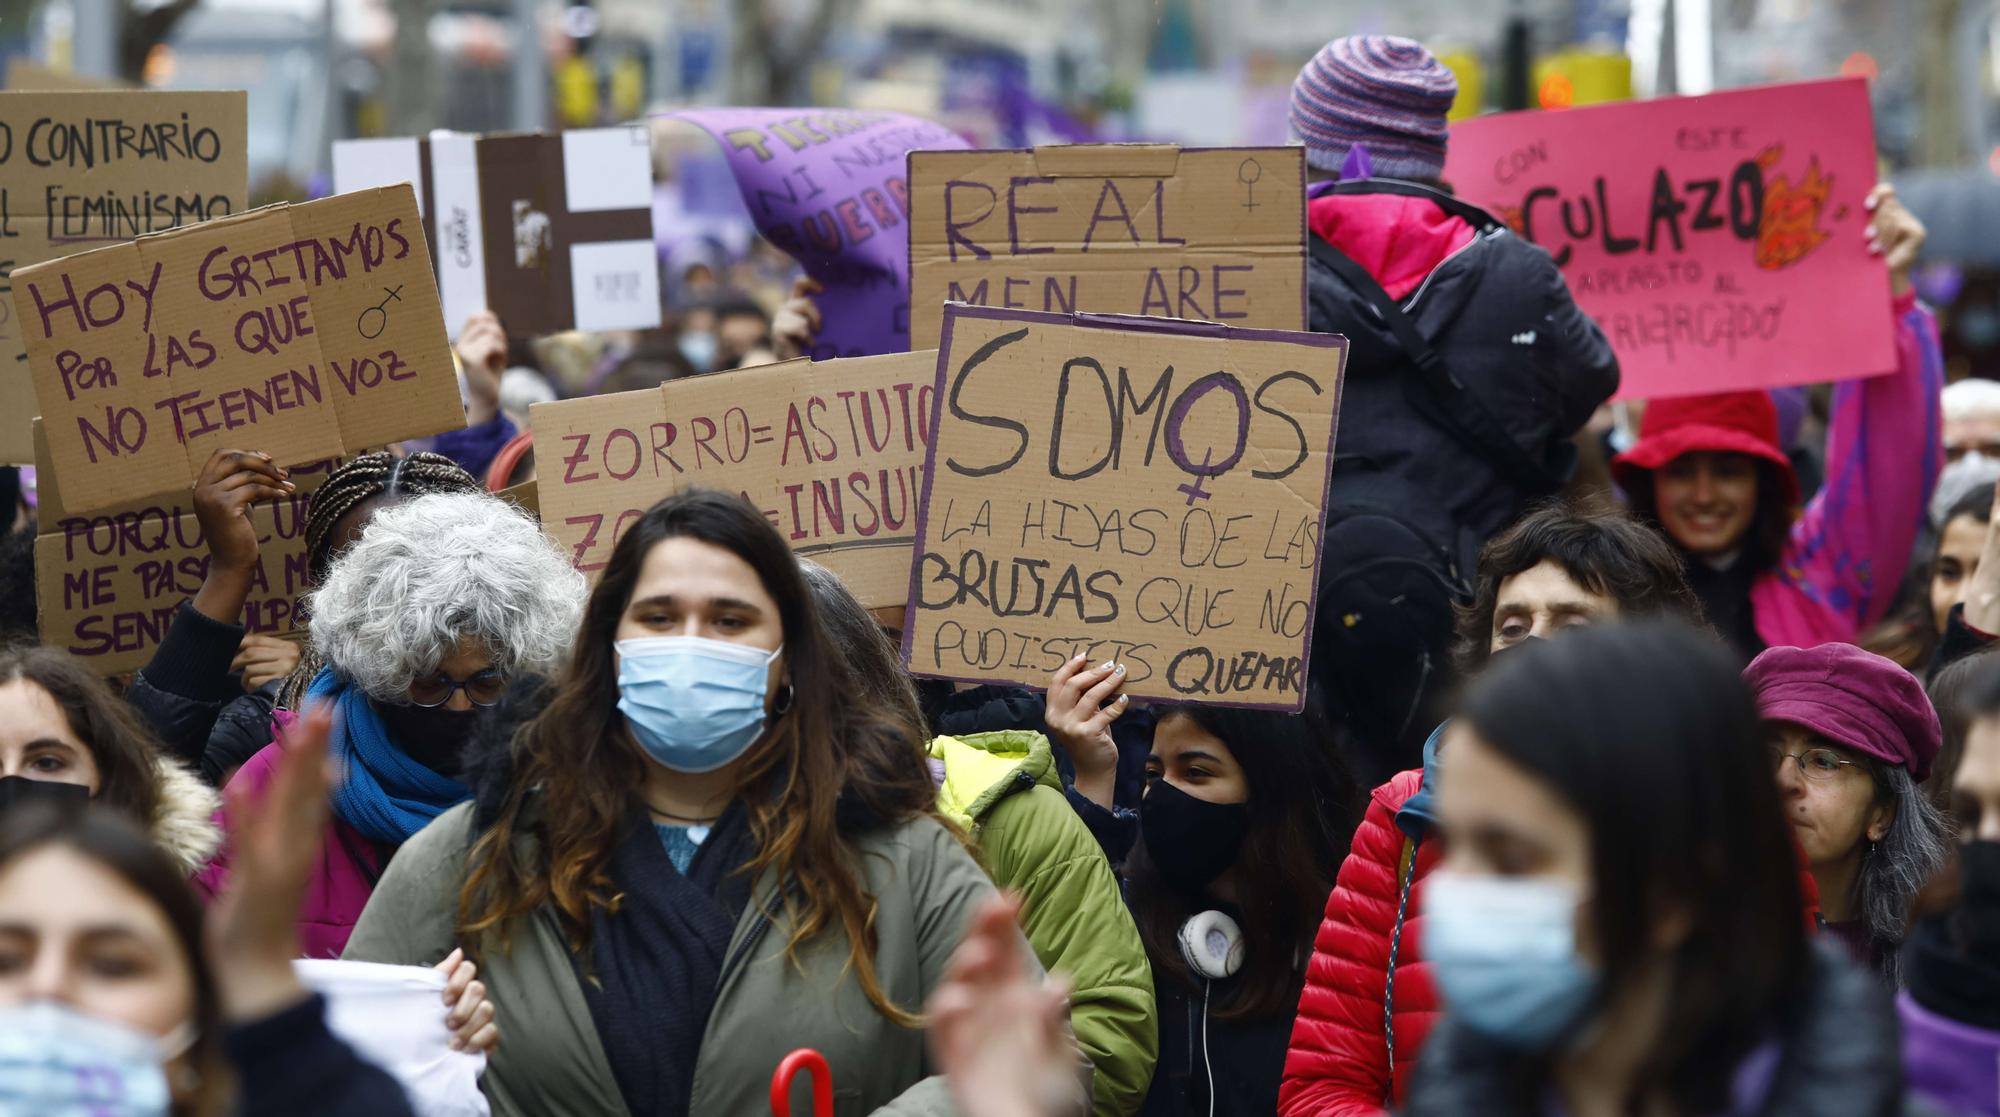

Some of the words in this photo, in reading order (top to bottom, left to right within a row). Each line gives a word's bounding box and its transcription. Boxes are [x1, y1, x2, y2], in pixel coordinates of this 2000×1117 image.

[26, 112, 221, 168] CONTRARIO
[1493, 140, 1548, 184] CON
[1675, 126, 1748, 151] ESTE
[944, 176, 1186, 263] REAL
[1521, 160, 1765, 268] CULAZO
[28, 262, 163, 338] HOY
[198, 218, 410, 301] GRITAMOS
[948, 275, 1078, 314] MEN
[1140, 264, 1254, 320] ARE
[1576, 259, 1702, 297] APLASTO
[1712, 272, 1745, 295] AL
[56, 350, 117, 400] POR
[143, 330, 217, 378] LAS
[234, 296, 314, 355] QUE
[77, 405, 147, 463] NO
[155, 364, 322, 446] TIENEN
[331, 350, 417, 396] VOZ
[946, 327, 1325, 505] SOMOS
[942, 498, 991, 542] LA
[1021, 499, 1168, 556] HIJAS
[1180, 507, 1253, 569] DE
[1264, 509, 1319, 569] LAS
[64, 565, 119, 610] ME
[133, 554, 213, 600] PAS
[916, 549, 1123, 623] BRUJAS
[1135, 577, 1235, 636] QUE
[1260, 583, 1309, 638] NO
[1166, 646, 1302, 695] QUEMAR
